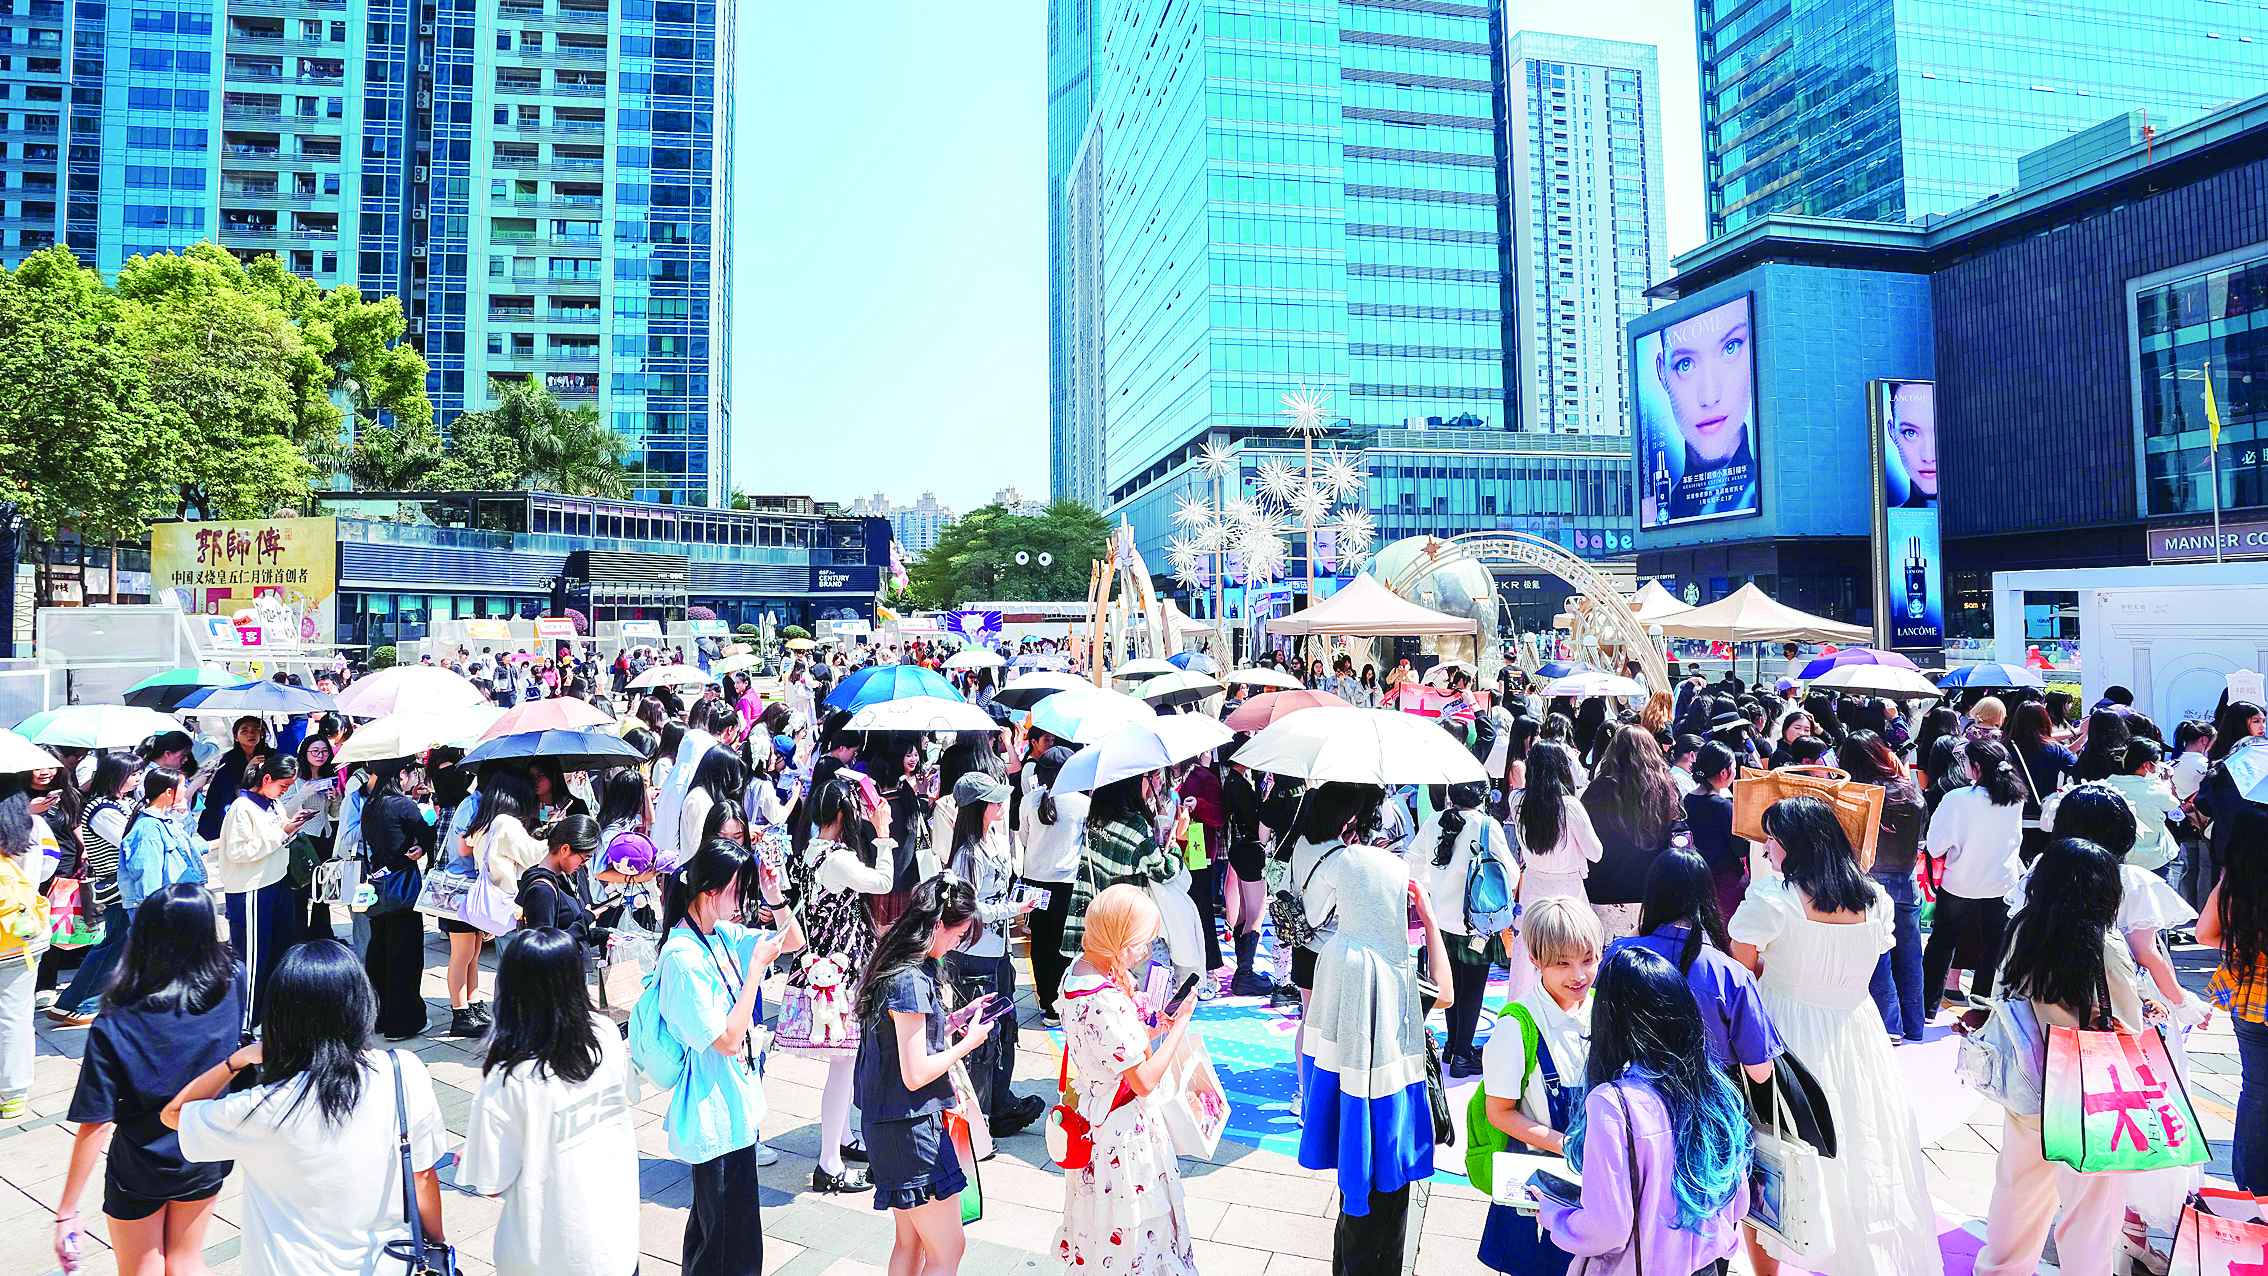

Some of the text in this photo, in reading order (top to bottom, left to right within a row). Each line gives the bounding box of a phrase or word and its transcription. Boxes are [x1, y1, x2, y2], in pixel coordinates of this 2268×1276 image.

[1575, 529, 1633, 549] babe
[2165, 534, 2239, 551] MANNER
[1507, 541, 1562, 572] LIGHT
[1565, 564, 1593, 588] UP
[171, 568, 309, 586] 中国叉烧皇五仁月饼首创者
[1897, 625, 1938, 636] LANCÔME
